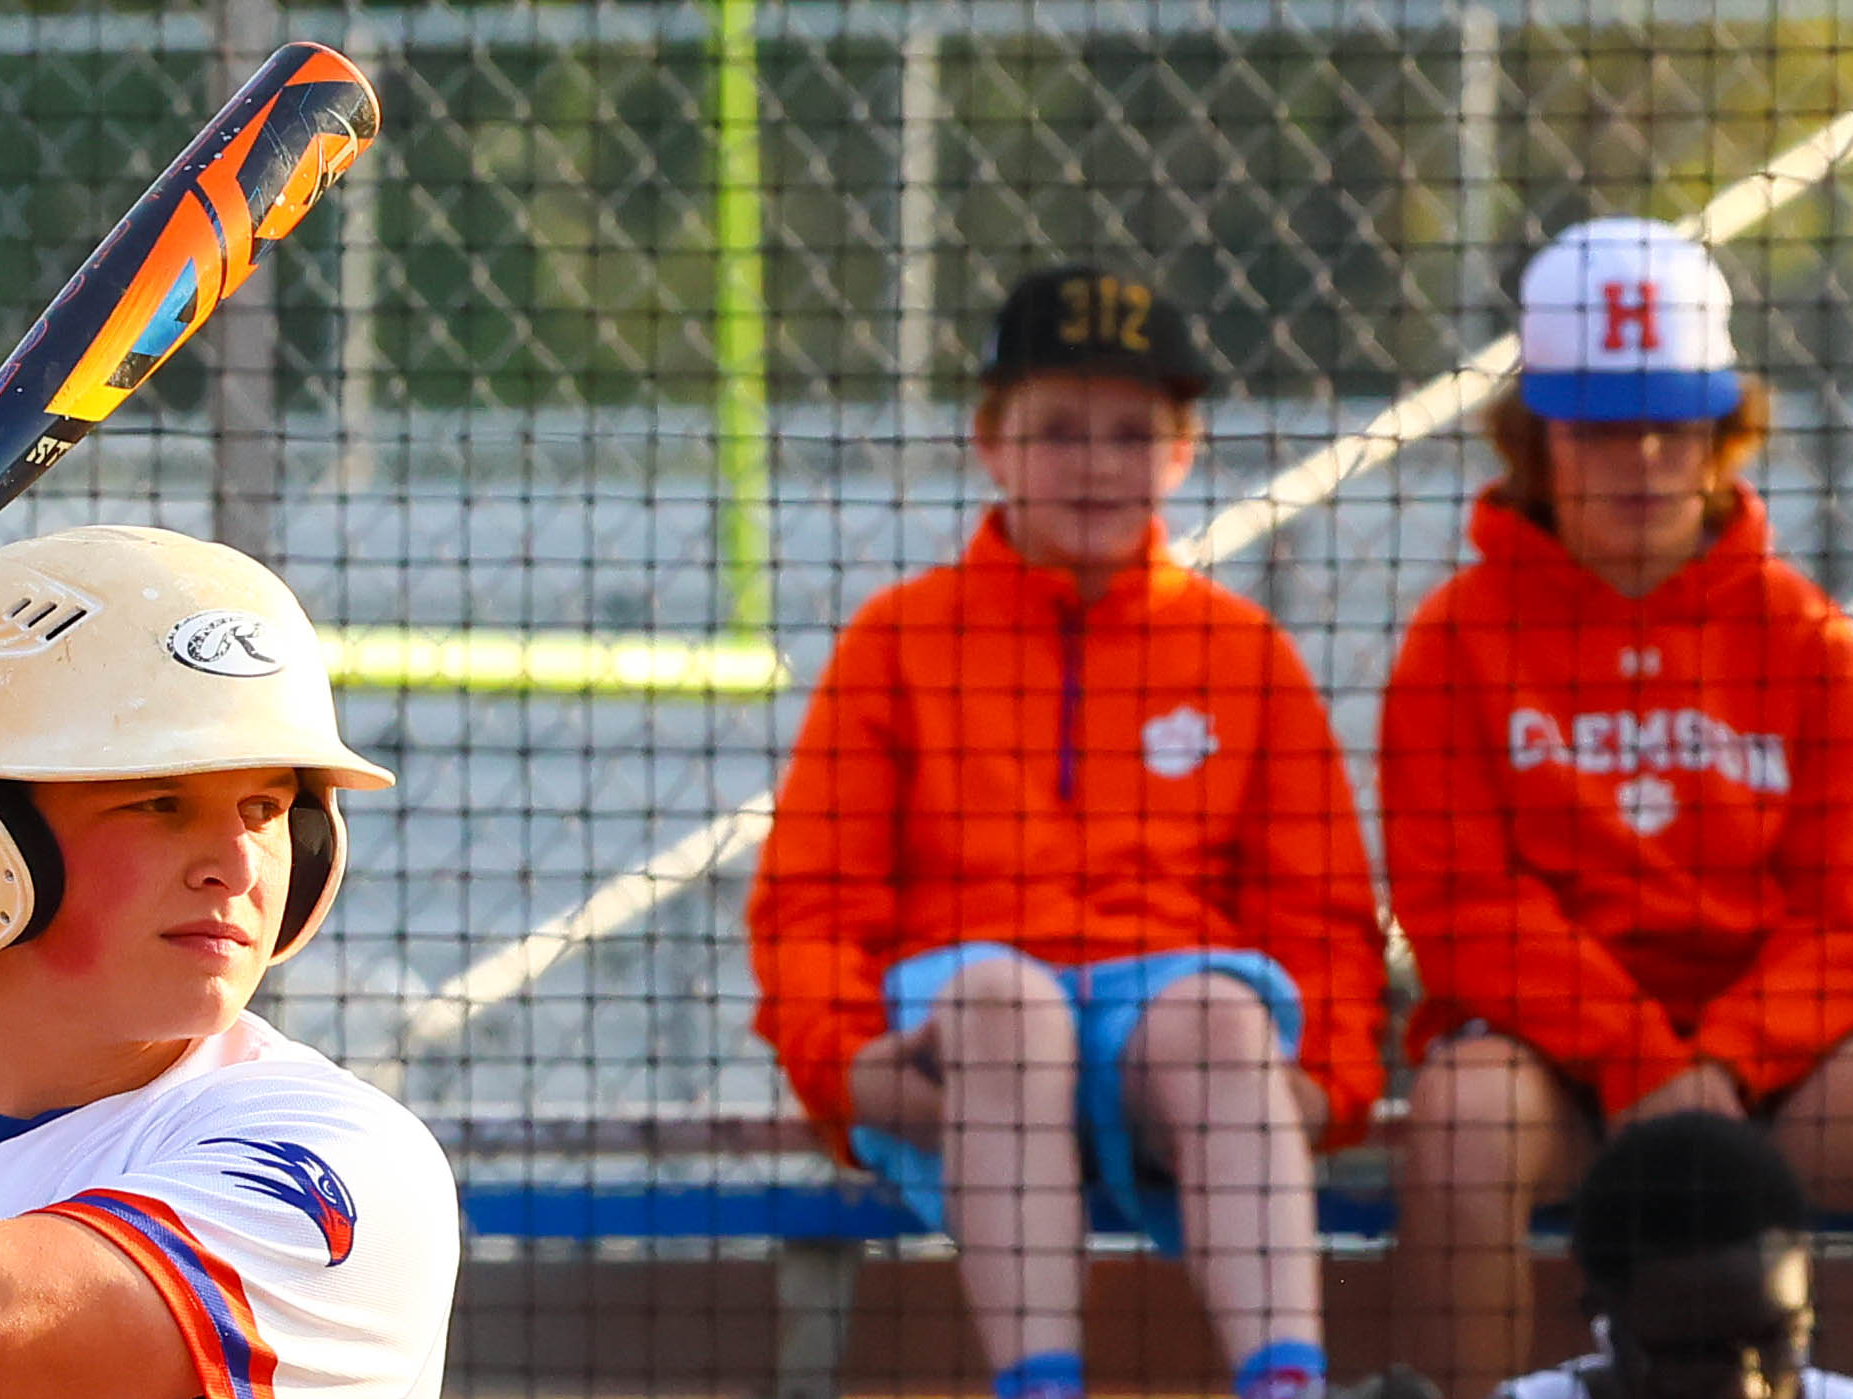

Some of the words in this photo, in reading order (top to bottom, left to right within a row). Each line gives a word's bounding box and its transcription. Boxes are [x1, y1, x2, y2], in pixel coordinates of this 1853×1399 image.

[1059, 276, 1153, 351] 312
[1601, 281, 1660, 350] H
[1507, 706, 1790, 794] CLEMSON
